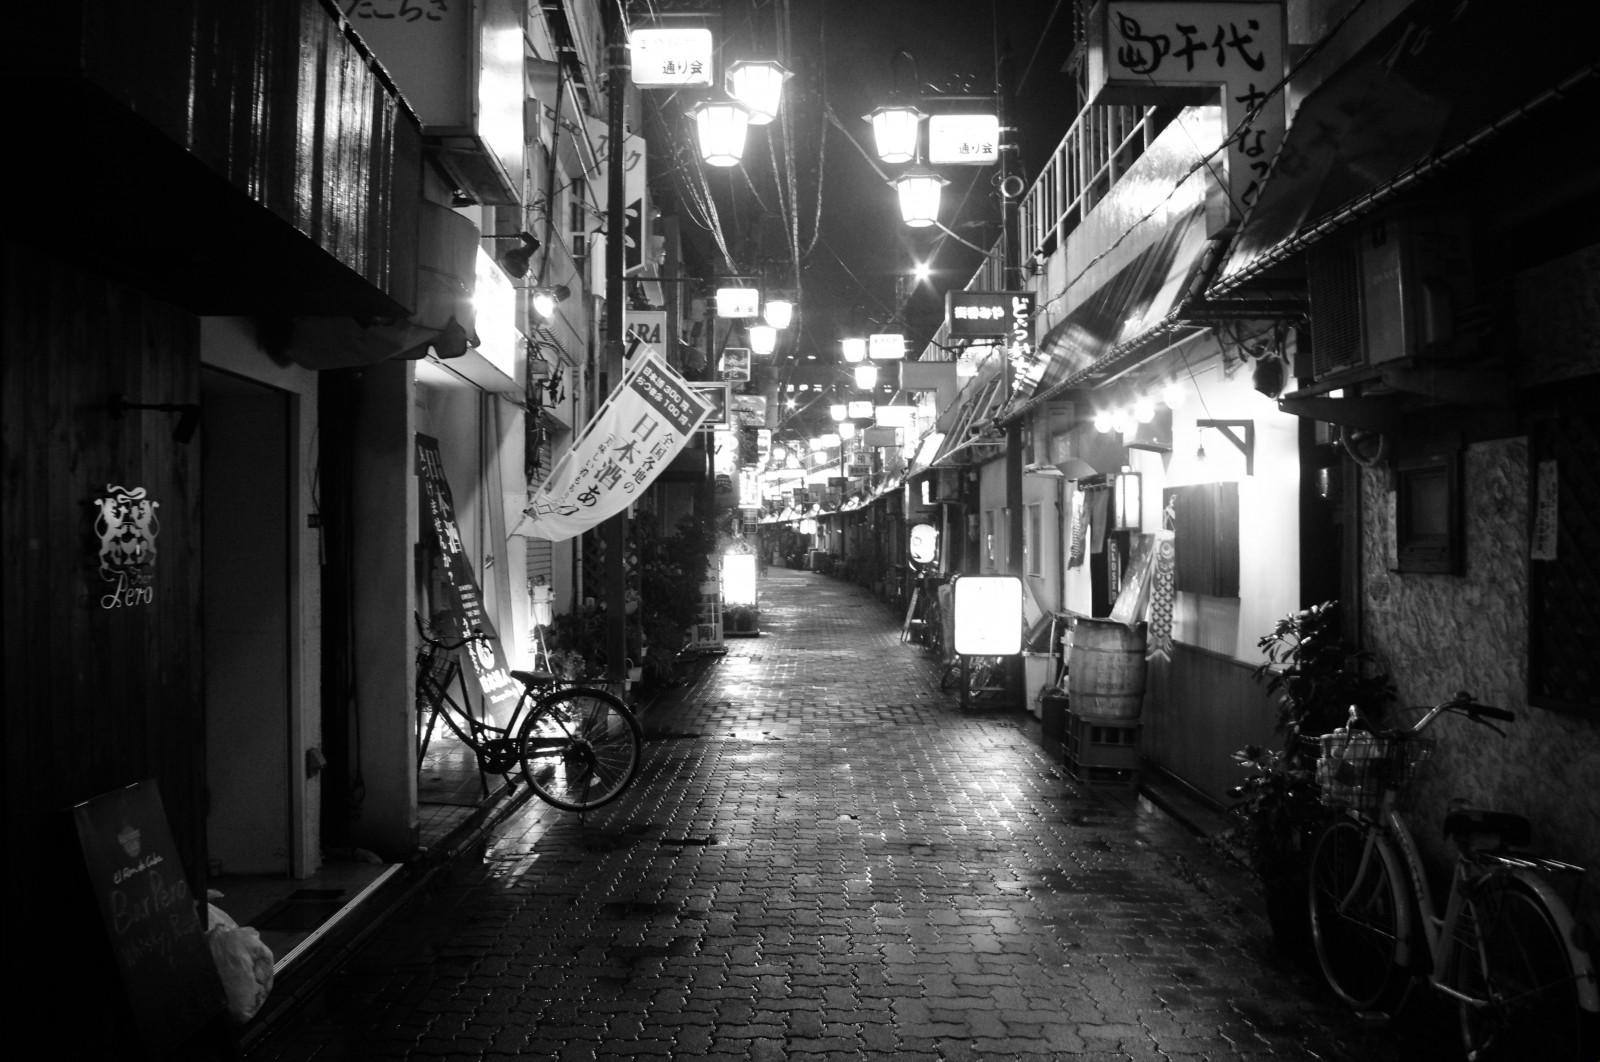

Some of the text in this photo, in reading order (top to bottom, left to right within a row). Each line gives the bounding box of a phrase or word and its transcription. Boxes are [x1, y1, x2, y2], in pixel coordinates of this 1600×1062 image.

[662, 60, 703, 75] 通り会
[959, 142, 993, 154] 通り会
[623, 431, 674, 494] 全国各地の
[424, 448, 462, 554] 日本酒
[111, 890, 150, 935] Bar
[149, 870, 188, 912] Pero
